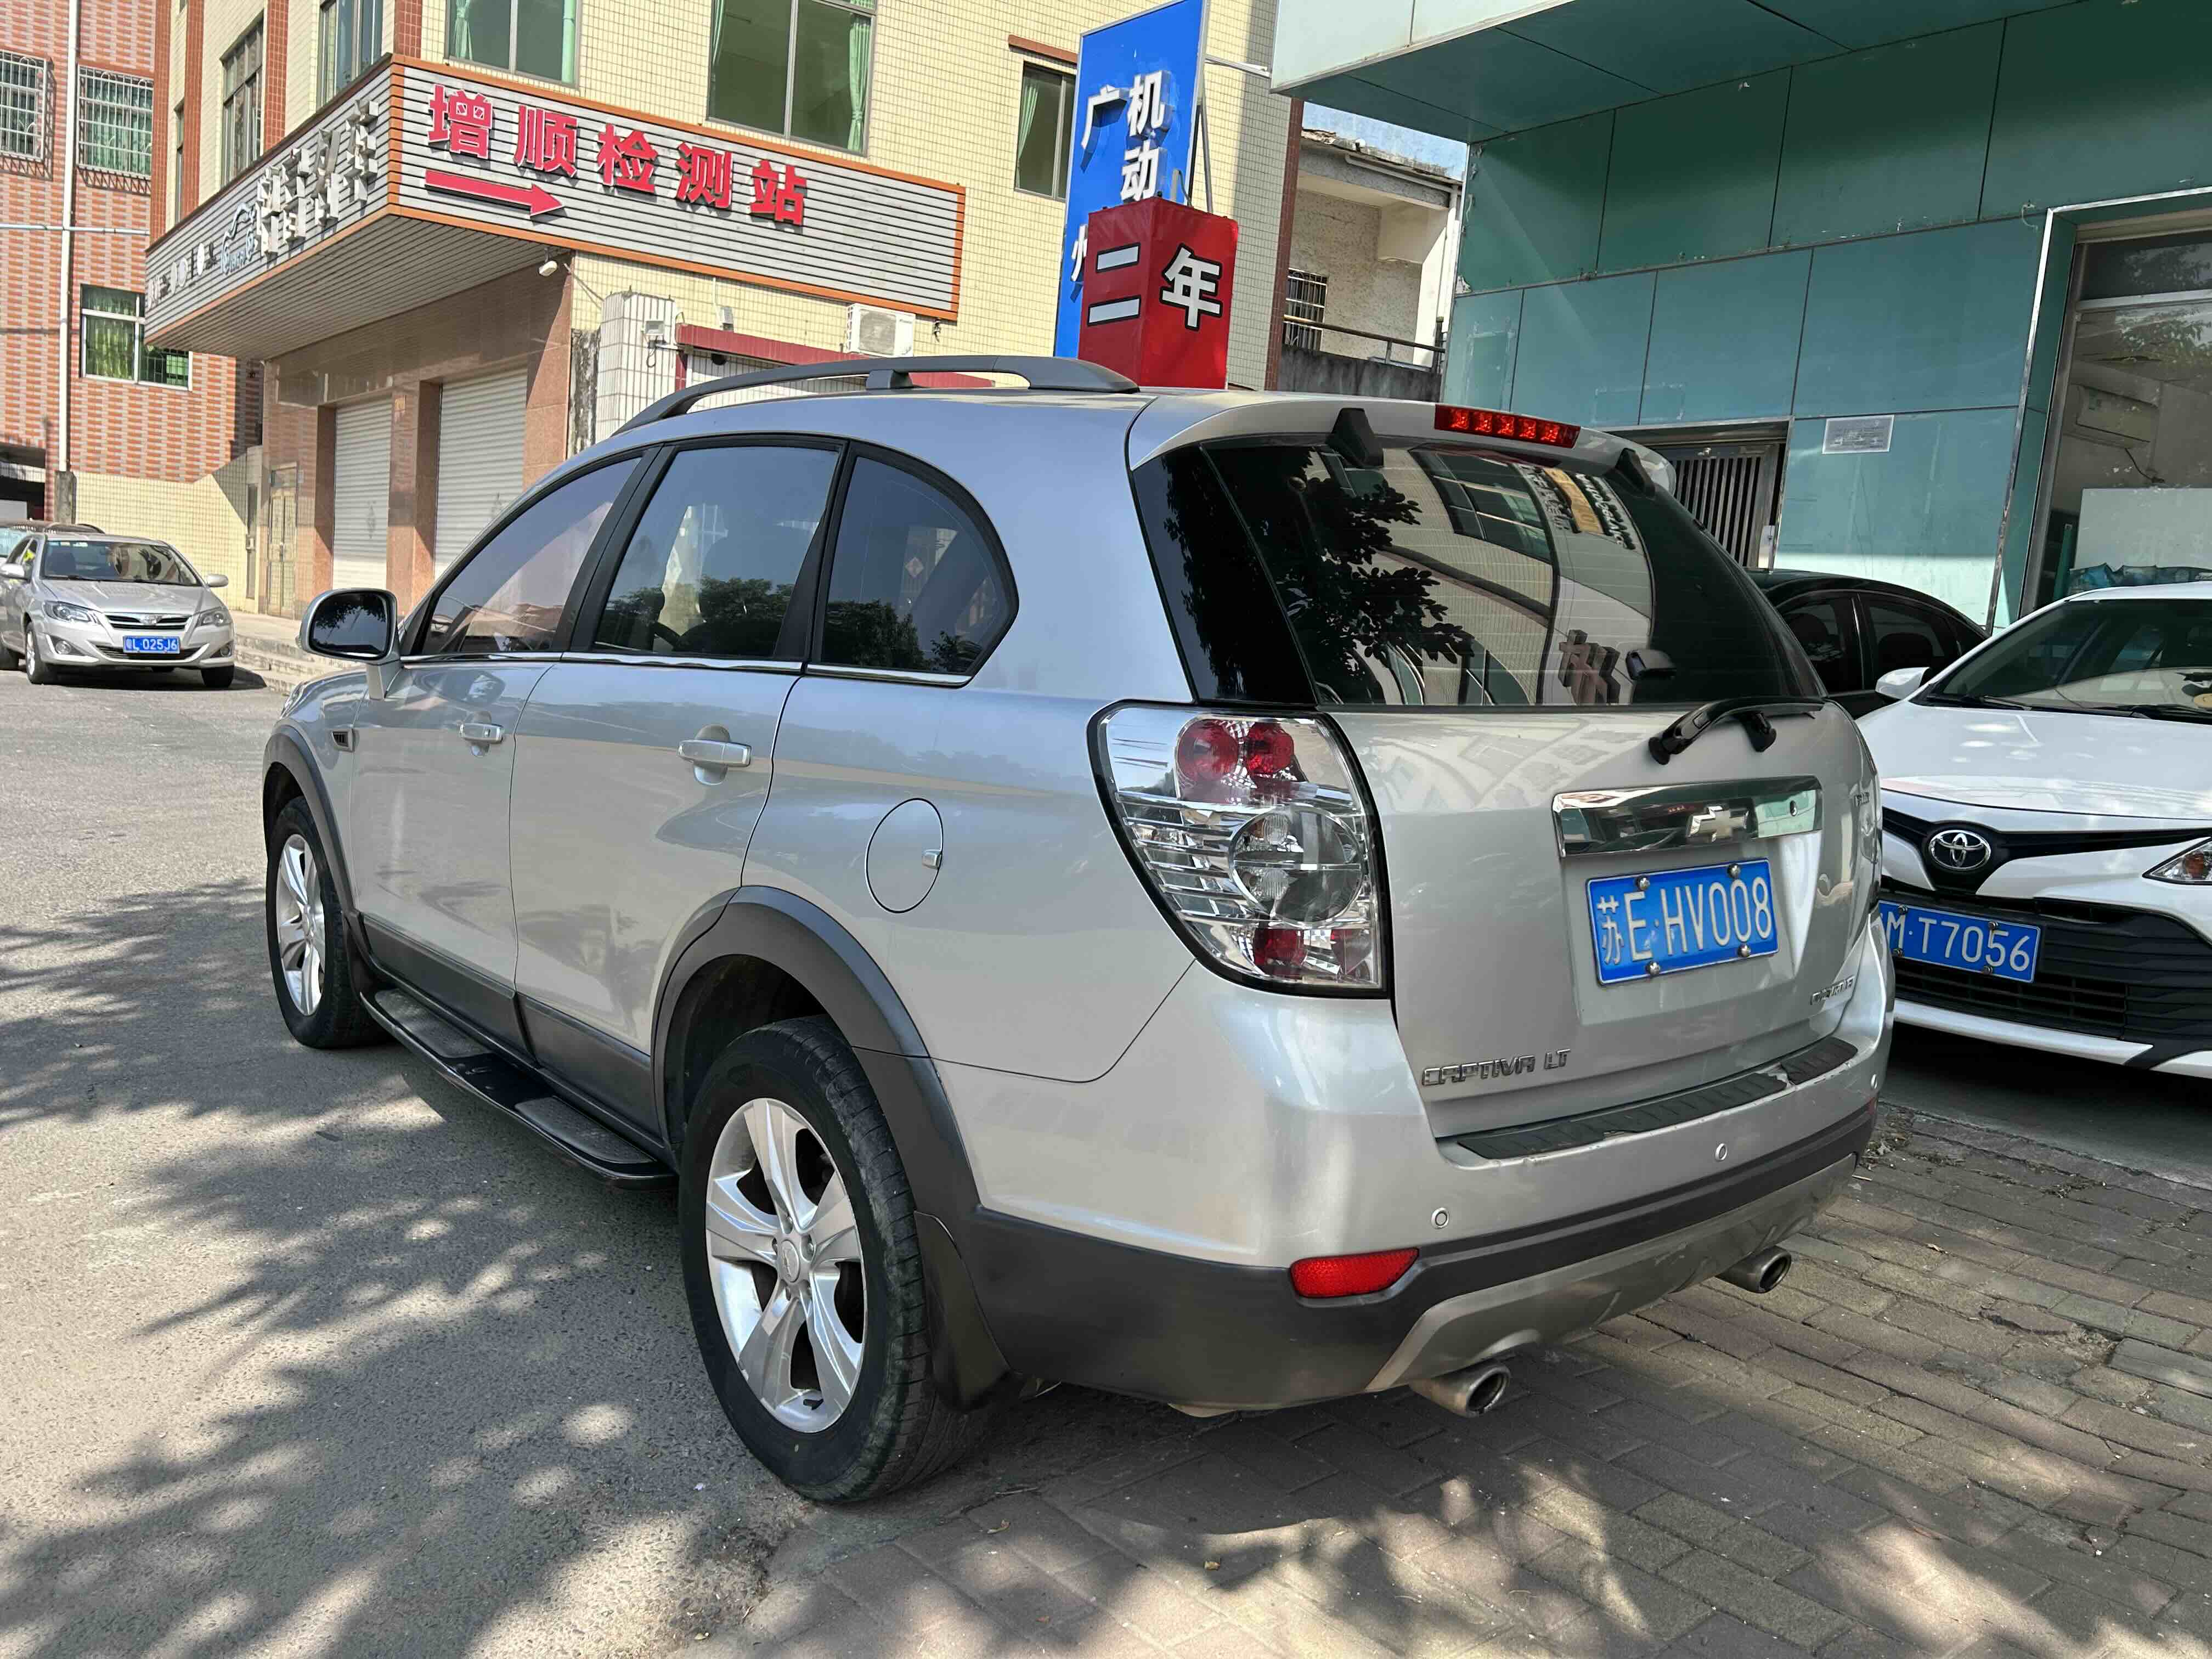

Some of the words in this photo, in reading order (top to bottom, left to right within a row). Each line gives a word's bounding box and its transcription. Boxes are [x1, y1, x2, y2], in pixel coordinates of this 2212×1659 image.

[427, 83, 807, 225] 增顺检测站
[1120, 70, 1164, 201] 机动
[1421, 1054, 1536, 1087] CAPTIVA
[1543, 1048, 1571, 1070] LT
